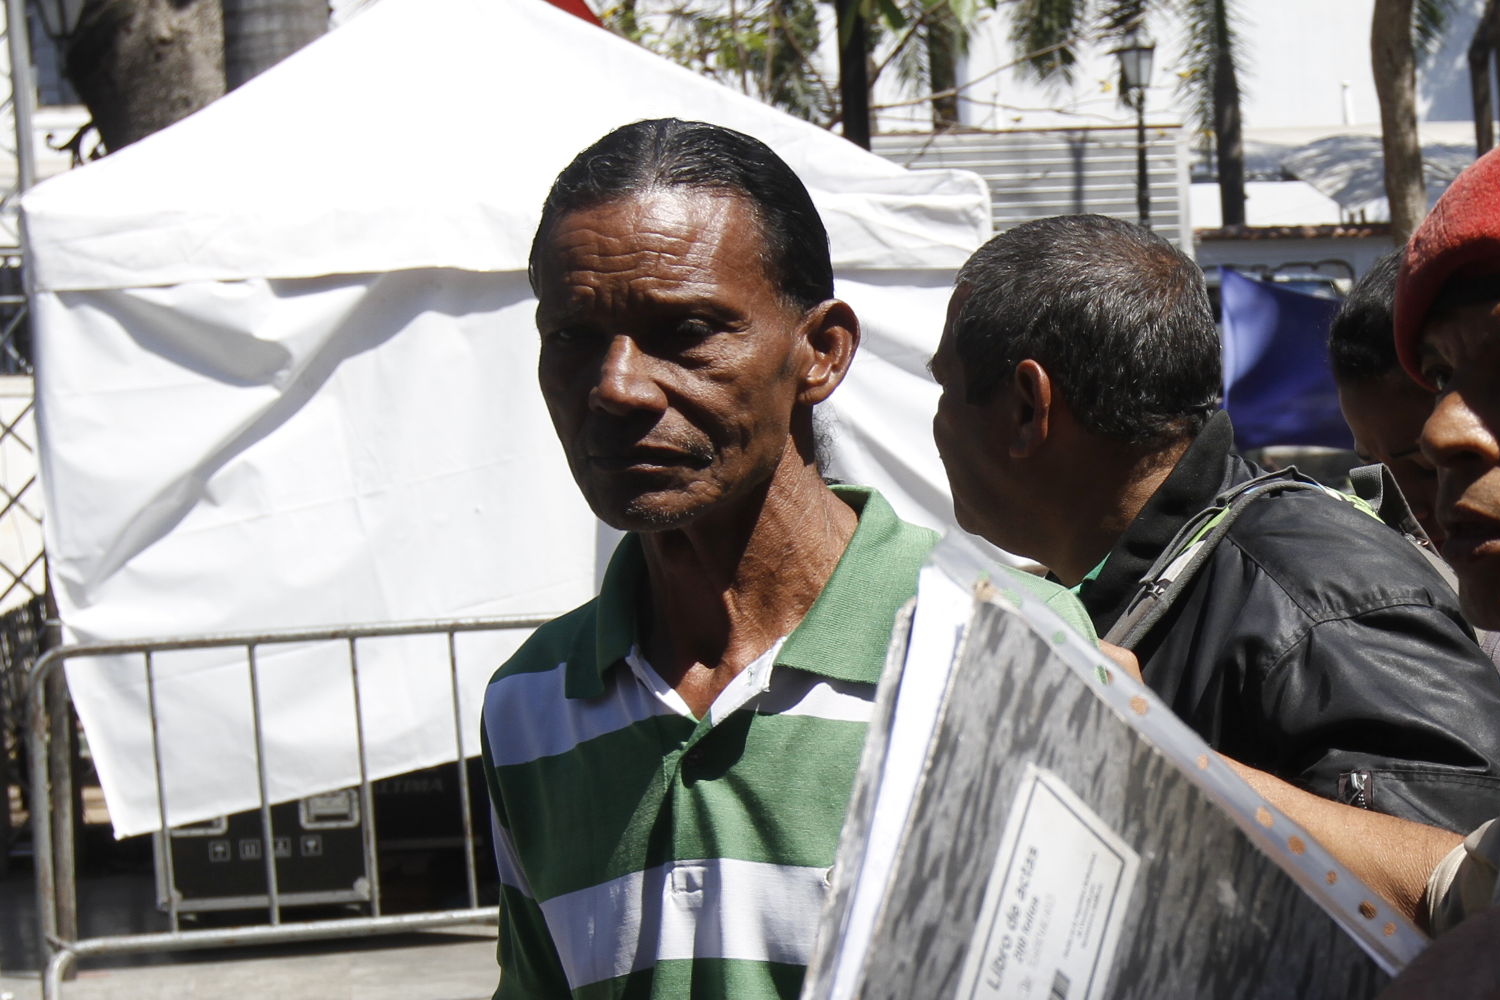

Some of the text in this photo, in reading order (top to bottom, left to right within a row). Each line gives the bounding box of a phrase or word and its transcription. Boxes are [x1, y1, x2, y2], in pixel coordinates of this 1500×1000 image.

[986, 933, 1013, 991] Libro
[1005, 903, 1020, 931] de
[1016, 846, 1038, 901] actas
